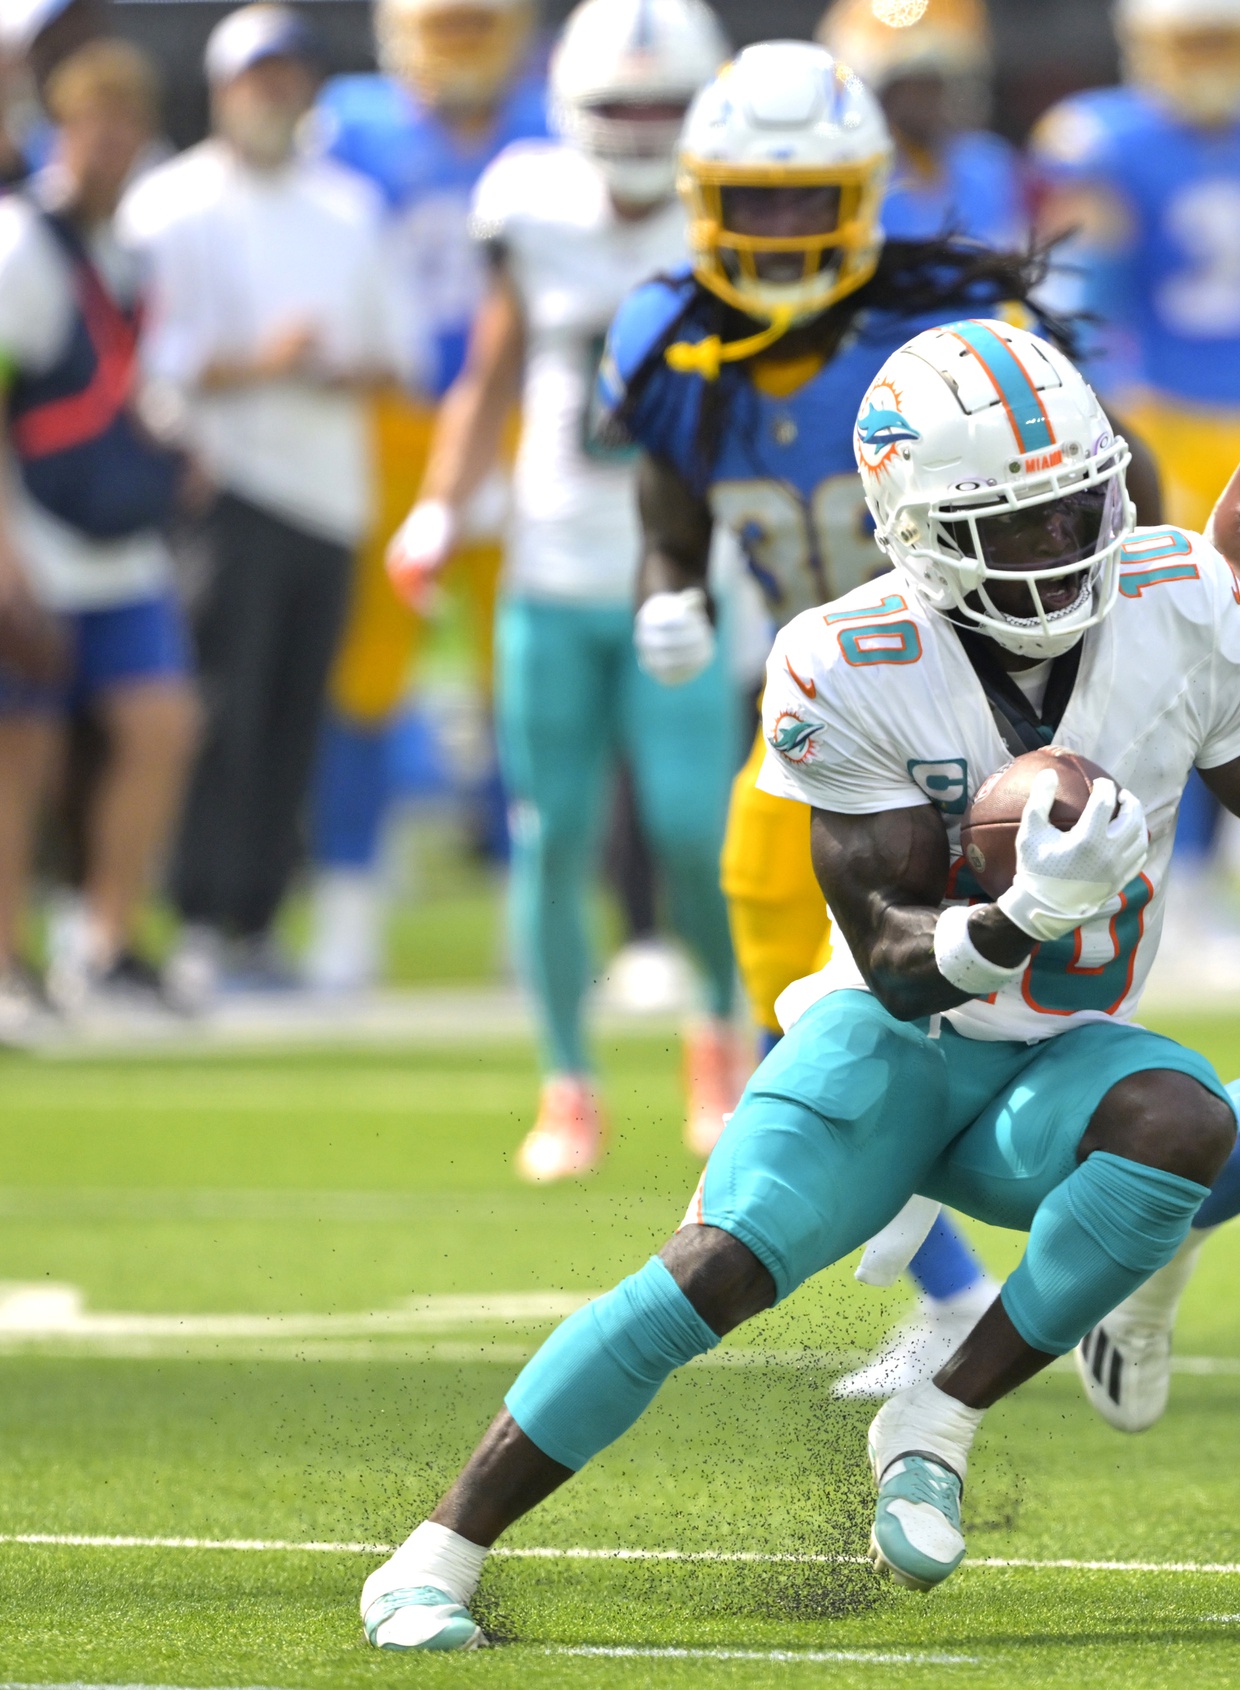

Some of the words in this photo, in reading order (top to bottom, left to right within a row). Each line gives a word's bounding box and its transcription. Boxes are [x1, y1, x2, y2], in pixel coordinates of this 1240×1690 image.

[1025, 449, 1063, 473] MIAMI
[1119, 530, 1200, 598] 10
[823, 594, 923, 667] 10
[912, 763, 964, 802] C
[945, 855, 1155, 1016] 0
